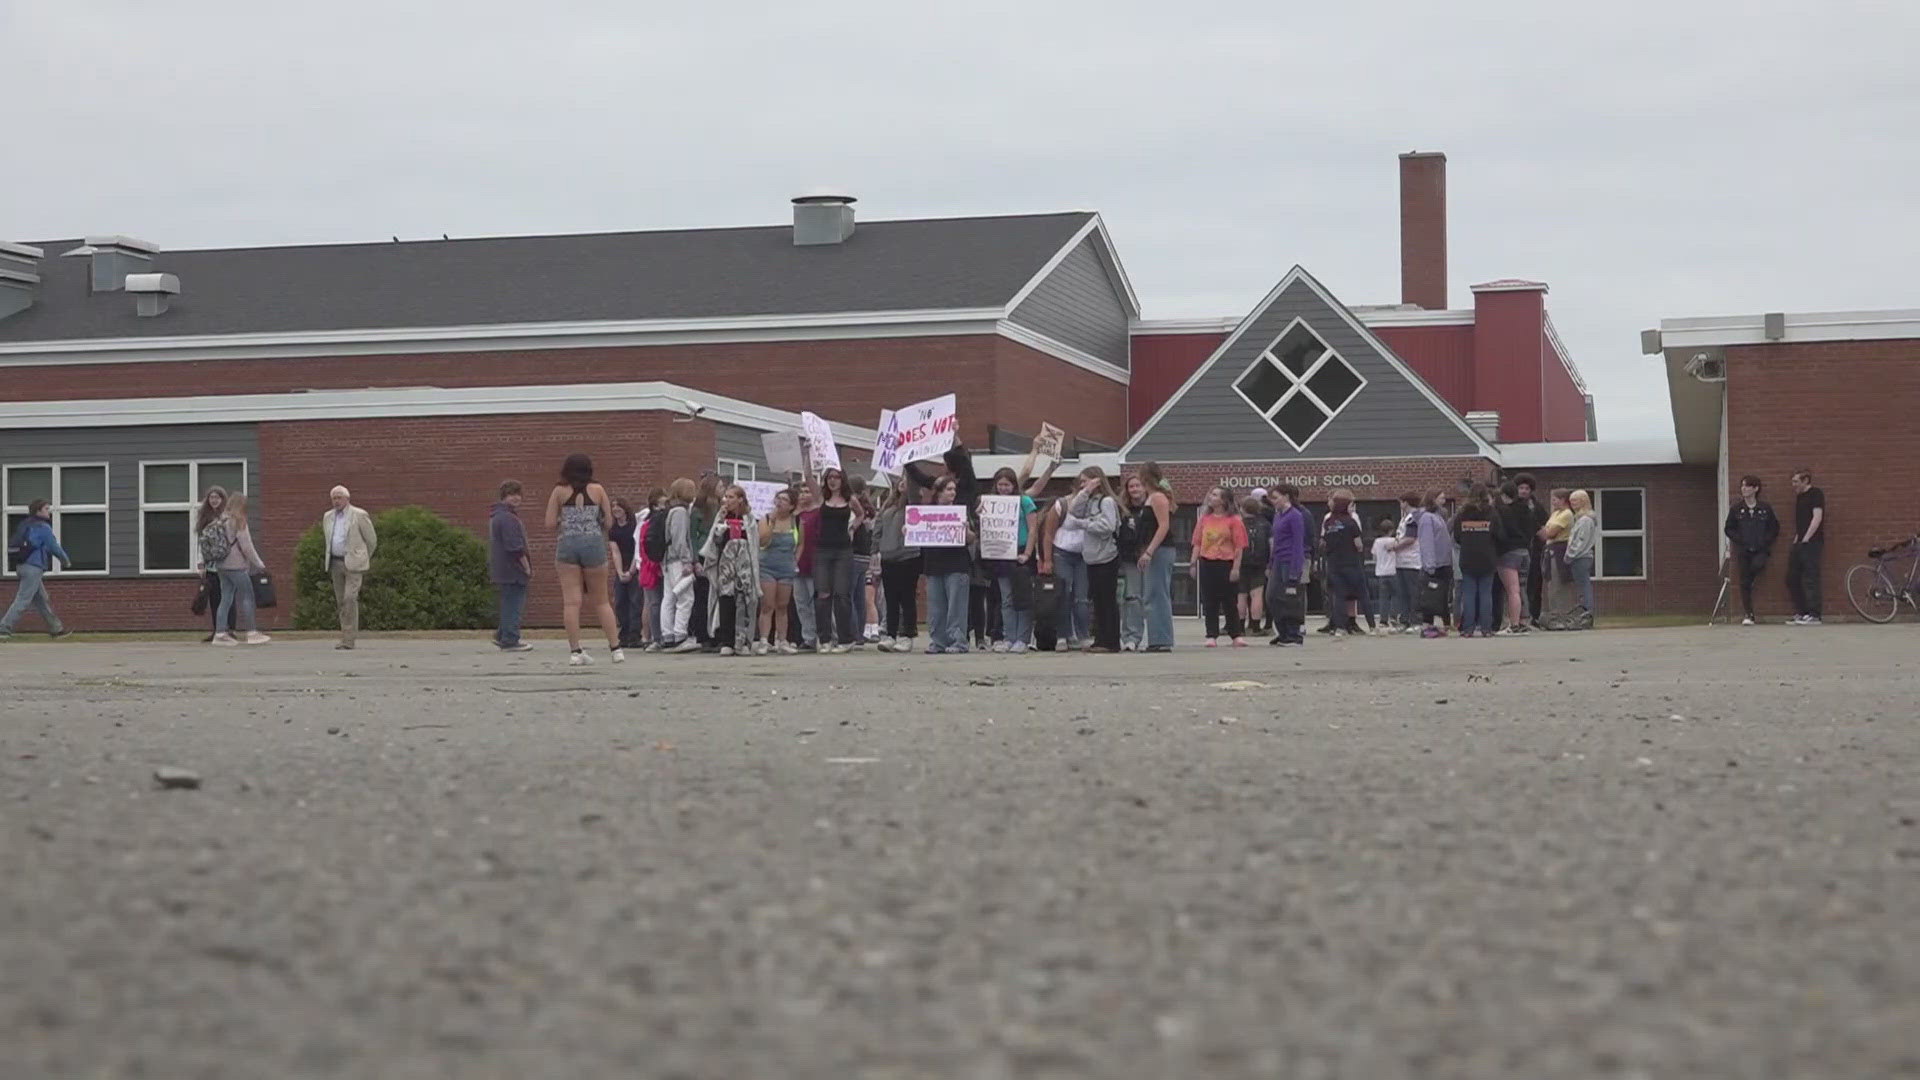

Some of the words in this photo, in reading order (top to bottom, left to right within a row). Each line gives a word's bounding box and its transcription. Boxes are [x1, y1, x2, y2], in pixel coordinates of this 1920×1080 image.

[899, 423, 927, 446] DOES
[931, 413, 957, 435] NOT
[1220, 476, 1280, 488] HOULTON
[1285, 475, 1317, 487] HIGH
[1323, 474, 1379, 486] SCHOOL
